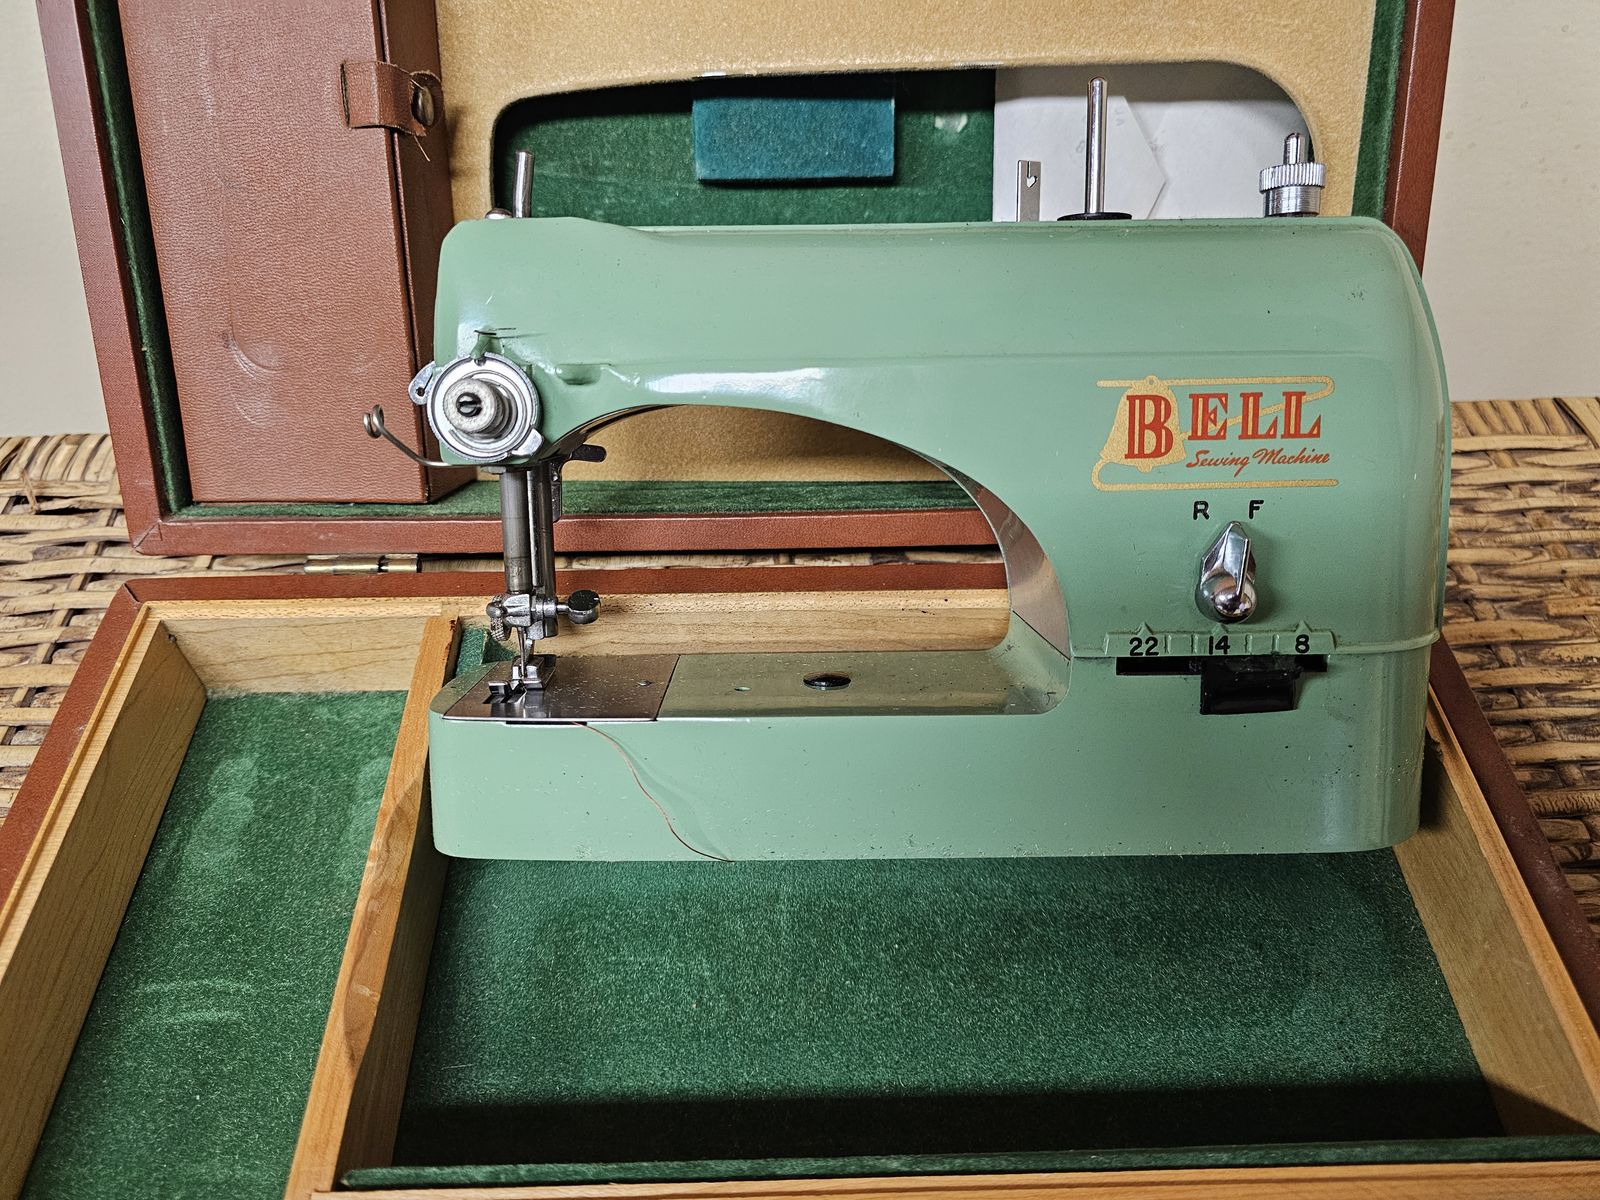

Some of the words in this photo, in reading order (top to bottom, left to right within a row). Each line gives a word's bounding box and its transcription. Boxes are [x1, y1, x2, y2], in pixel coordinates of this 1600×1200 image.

[1125, 391, 1322, 460] BELL
[1186, 449, 1250, 478] Sewing
[1252, 447, 1330, 465] Machine
[1192, 500, 1210, 520] R
[1248, 499, 1265, 519] F
[1129, 636, 1160, 656] 22
[1208, 635, 1231, 655] 14
[1294, 633, 1311, 654] 8
